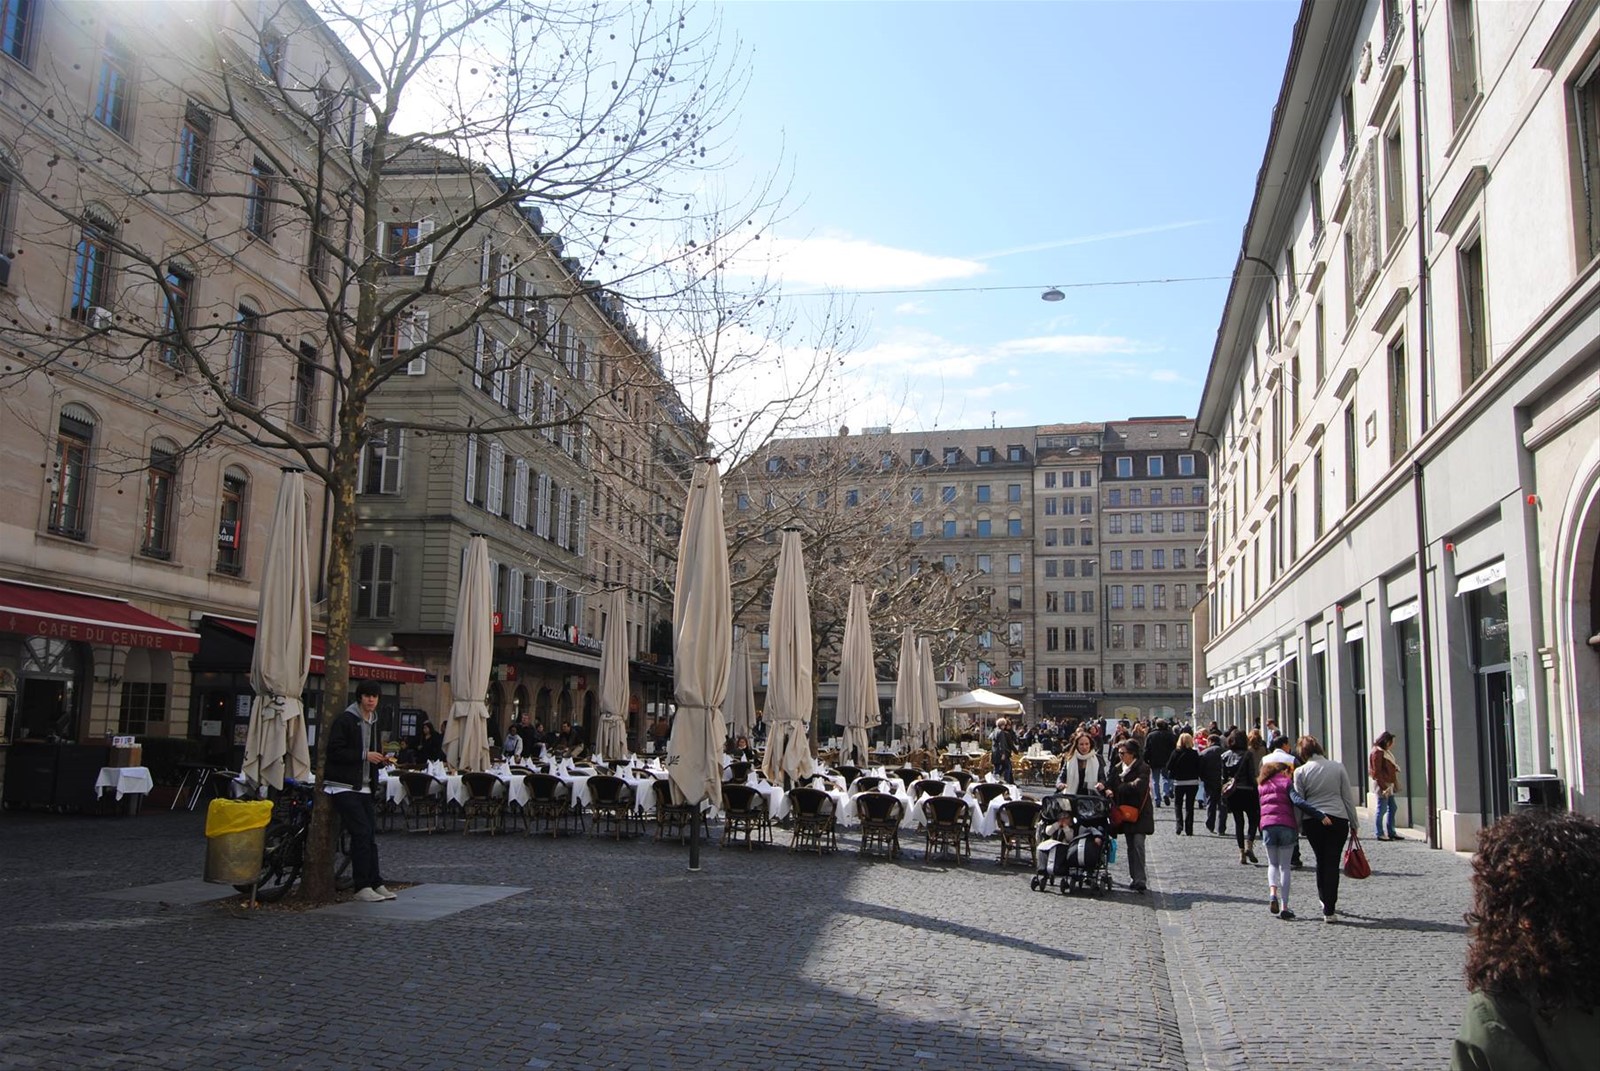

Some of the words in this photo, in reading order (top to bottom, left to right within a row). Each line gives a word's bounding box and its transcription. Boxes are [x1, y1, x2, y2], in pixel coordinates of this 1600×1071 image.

[218, 534, 234, 542] OUER
[86, 627, 104, 641] DU
[112, 631, 163, 648] CENTRE
[542, 625, 567, 642] PIZZERIA
[359, 667, 369, 677] DU
[371, 668, 397, 680] CENTRE
